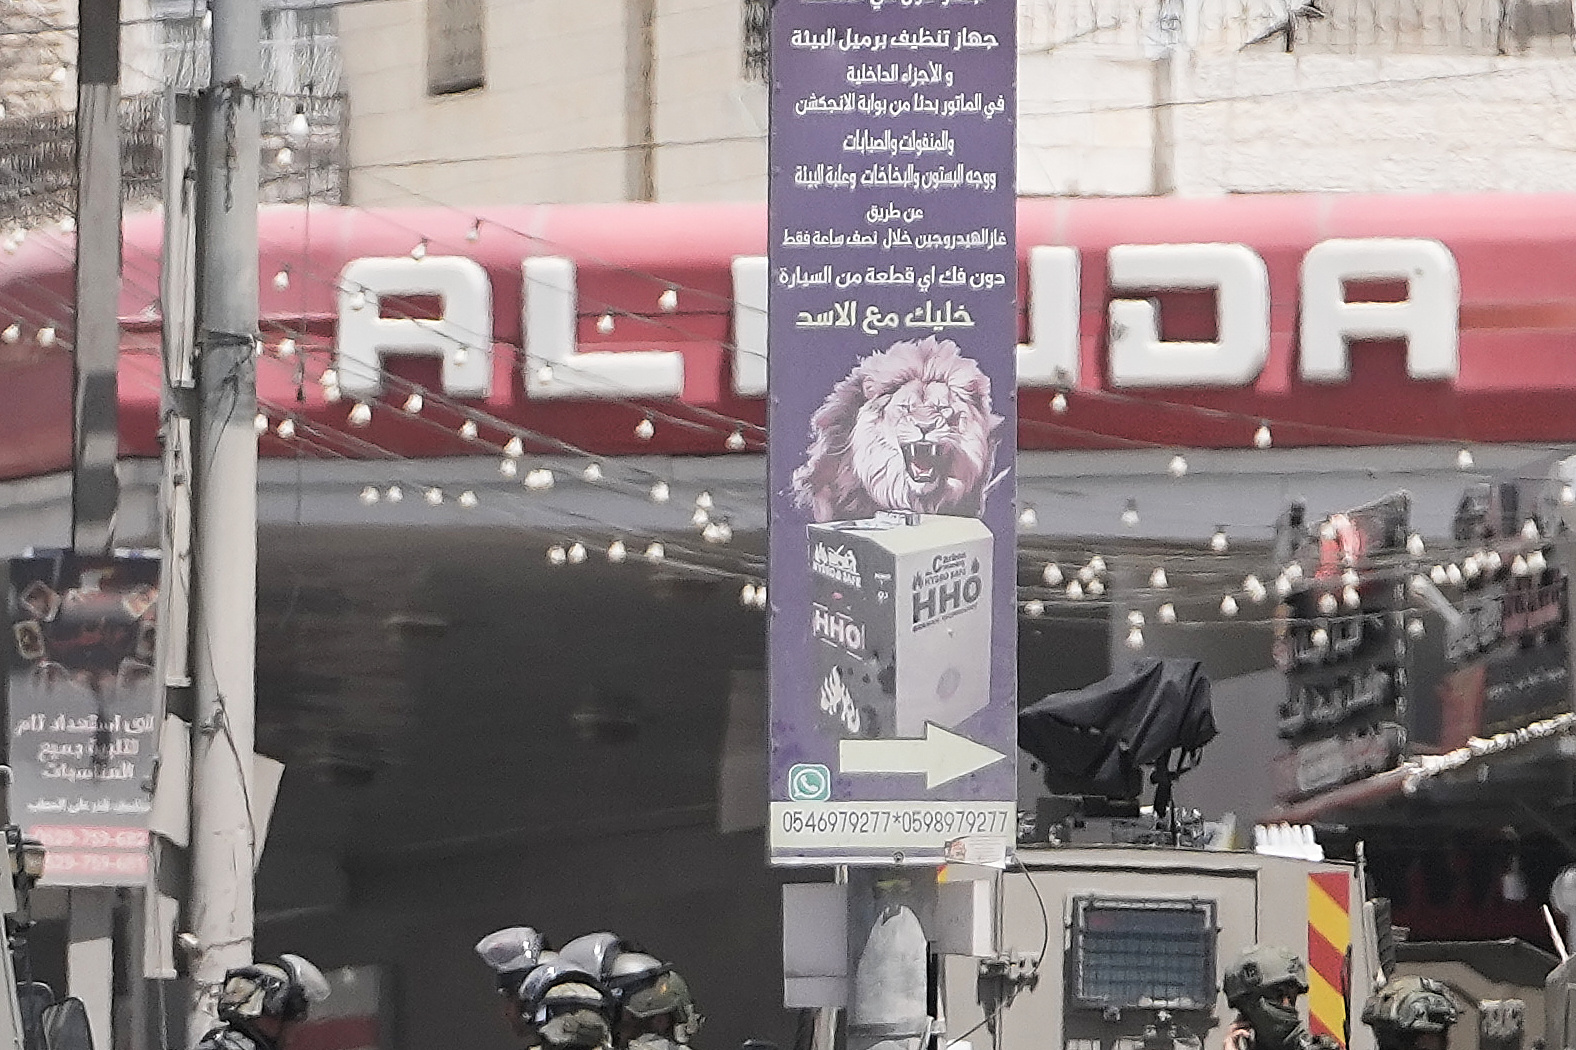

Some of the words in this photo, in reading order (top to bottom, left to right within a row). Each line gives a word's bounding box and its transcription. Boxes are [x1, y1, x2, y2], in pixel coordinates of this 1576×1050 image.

[791, 27, 836, 50] البيئة
[838, 28, 887, 50] برميل
[890, 27, 951, 50] تنظيف
[953, 26, 999, 50] جهاز
[846, 63, 899, 84] الداخلية
[795, 92, 856, 116] الانجكشن
[858, 92, 886, 116] بوابة
[889, 100, 911, 116] من
[941, 92, 982, 116] الماتور
[984, 95, 1005, 119] في
[794, 163, 824, 189] البيئة
[825, 163, 857, 190] وعلبة
[965, 168, 997, 191] ووجه
[866, 201, 901, 223] طريق
[902, 206, 924, 222] عن
[781, 228, 810, 246] فقط
[812, 229, 844, 246] ساعة
[846, 229, 878, 246] نصف
[882, 227, 912, 249] خلال
[778, 264, 832, 289] السيارة
[835, 269, 862, 289] من
[865, 265, 915, 284] قطعة
[917, 265, 936, 292] اي
[938, 265, 966, 285] فك
[969, 270, 1006, 289] دون
[795, 299, 857, 328] الاسد
[861, 303, 900, 335] مع
[904, 299, 976, 331] خليك
[912, 575, 982, 625] HHO
[815, 609, 862, 650] HHO
